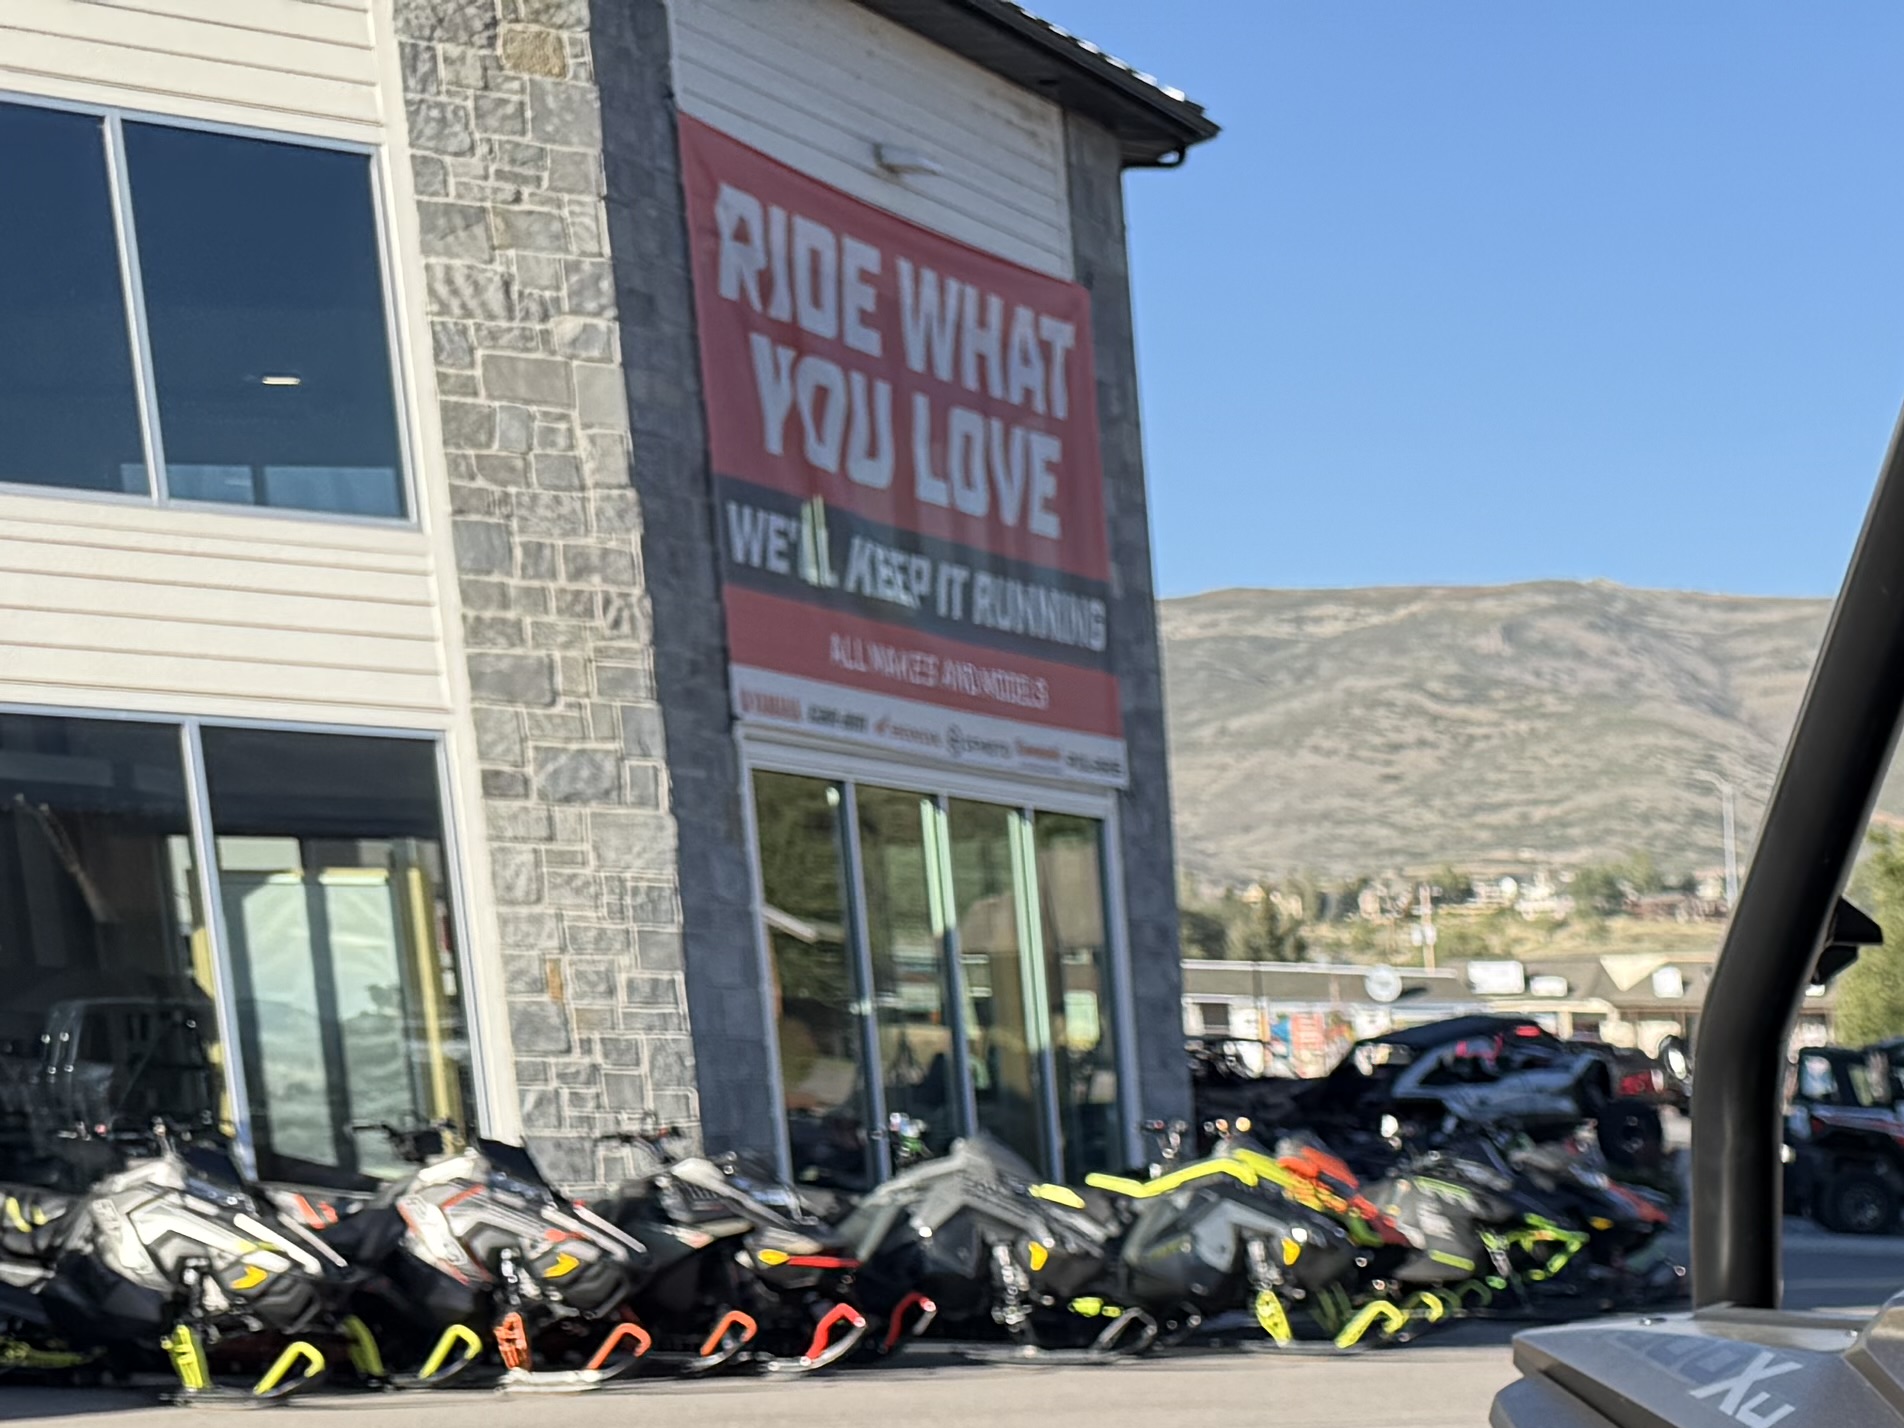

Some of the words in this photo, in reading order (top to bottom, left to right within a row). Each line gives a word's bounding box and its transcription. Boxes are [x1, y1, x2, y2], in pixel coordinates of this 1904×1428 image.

[716, 182, 882, 358] RIDE
[897, 257, 1075, 420] WHAT
[749, 332, 894, 489] YOU
[912, 393, 1061, 540] LOVE
[727, 502, 838, 588] WE'LL
[844, 536, 930, 605] KEEP
[936, 560, 971, 621] IT
[972, 572, 1107, 652] RUNNING
[830, 633, 867, 672] ALL
[941, 656, 981, 696] AND
